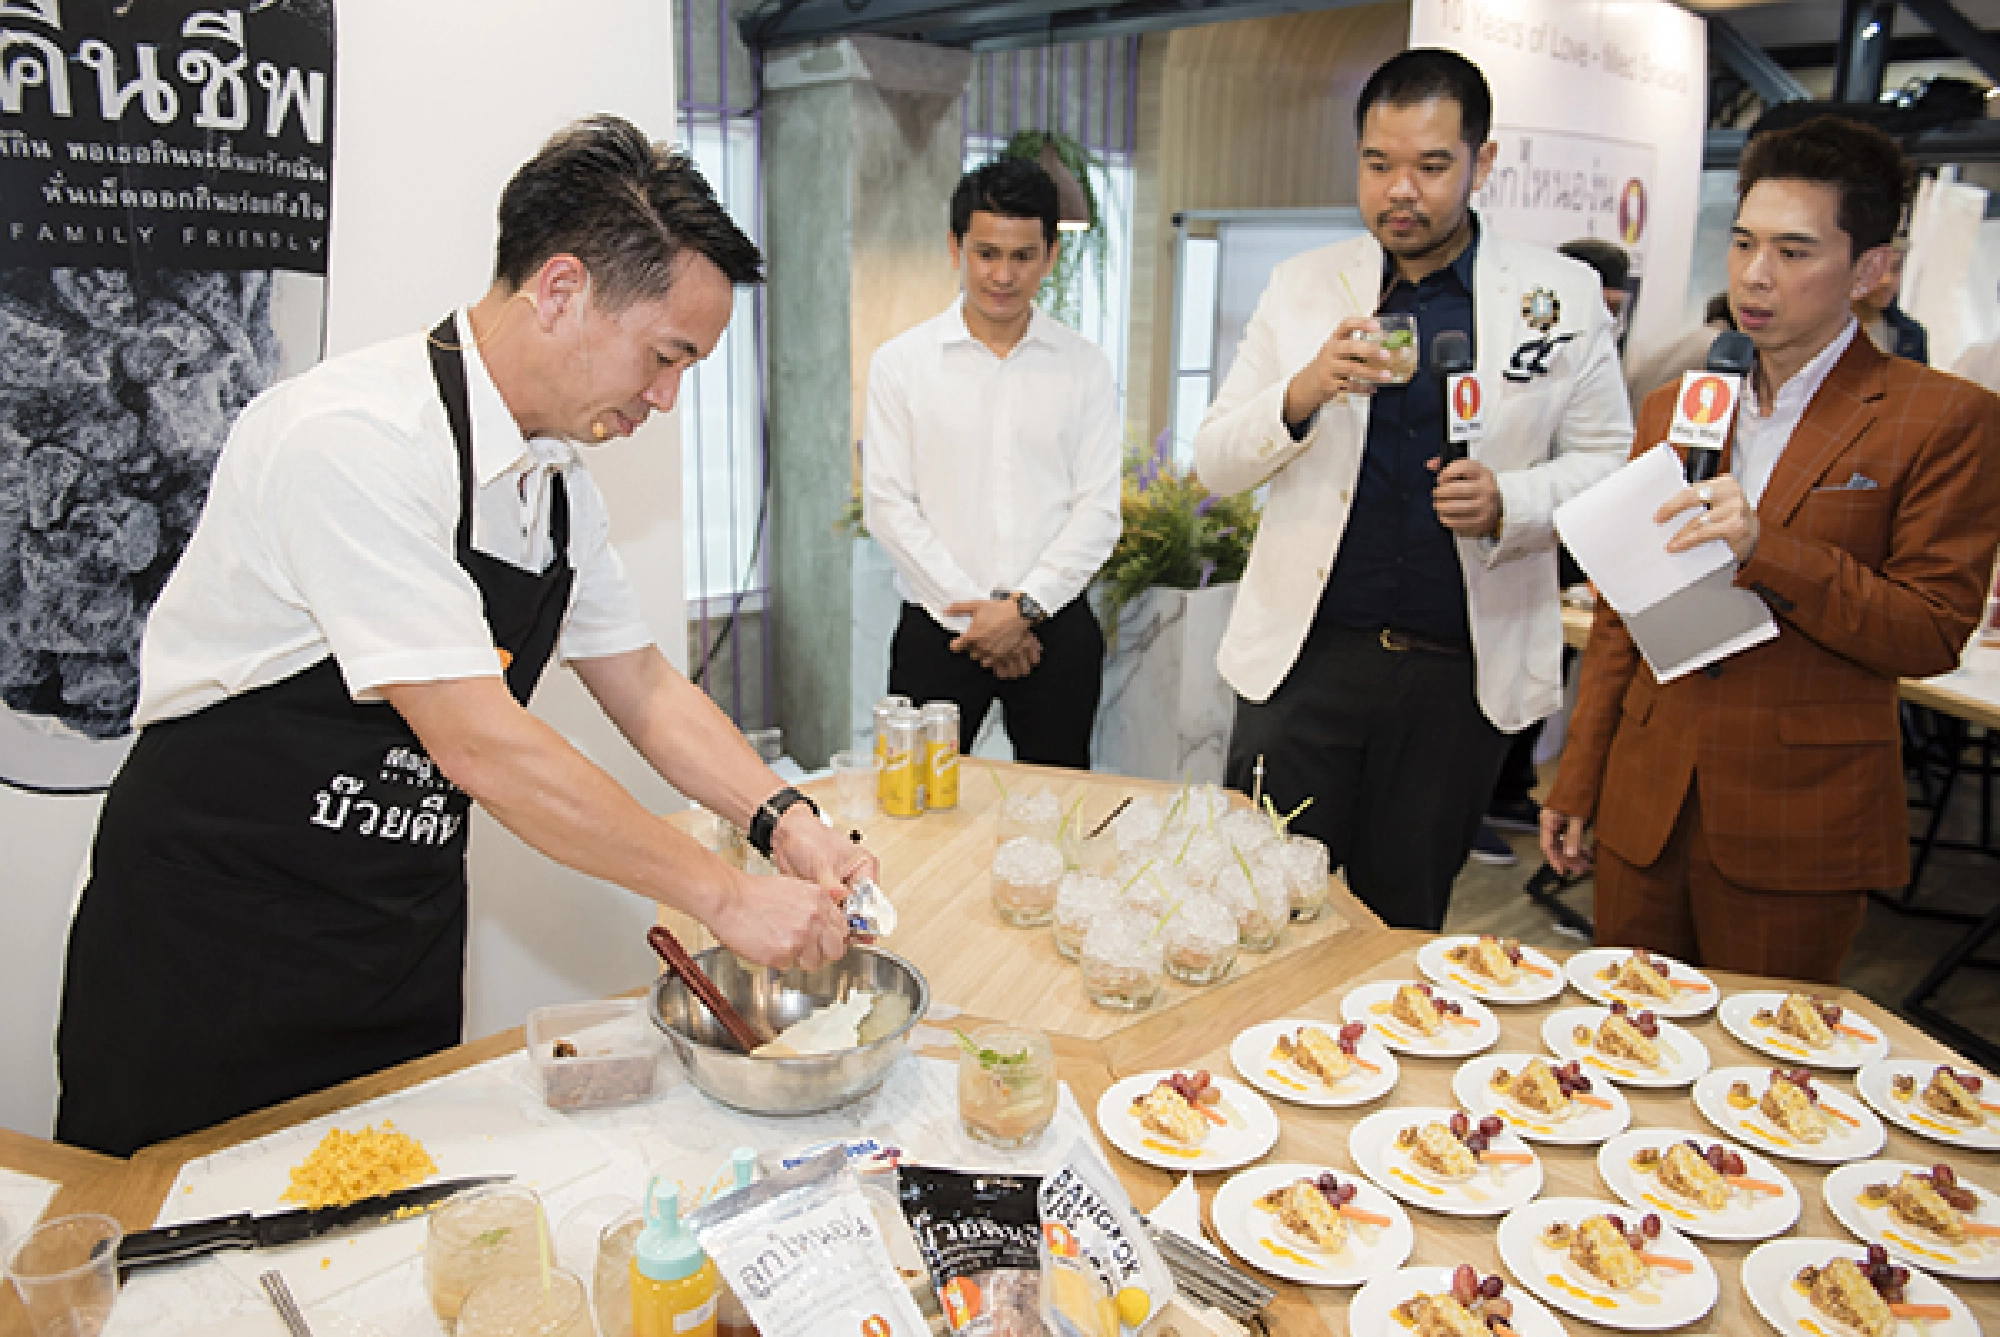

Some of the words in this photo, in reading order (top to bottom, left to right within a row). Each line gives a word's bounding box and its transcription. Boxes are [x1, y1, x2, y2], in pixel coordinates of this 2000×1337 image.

[10, 222, 154, 244] FAMILY
[182, 226, 325, 254] FRIENDLY
[1052, 1168, 1141, 1281] BANGKOK
